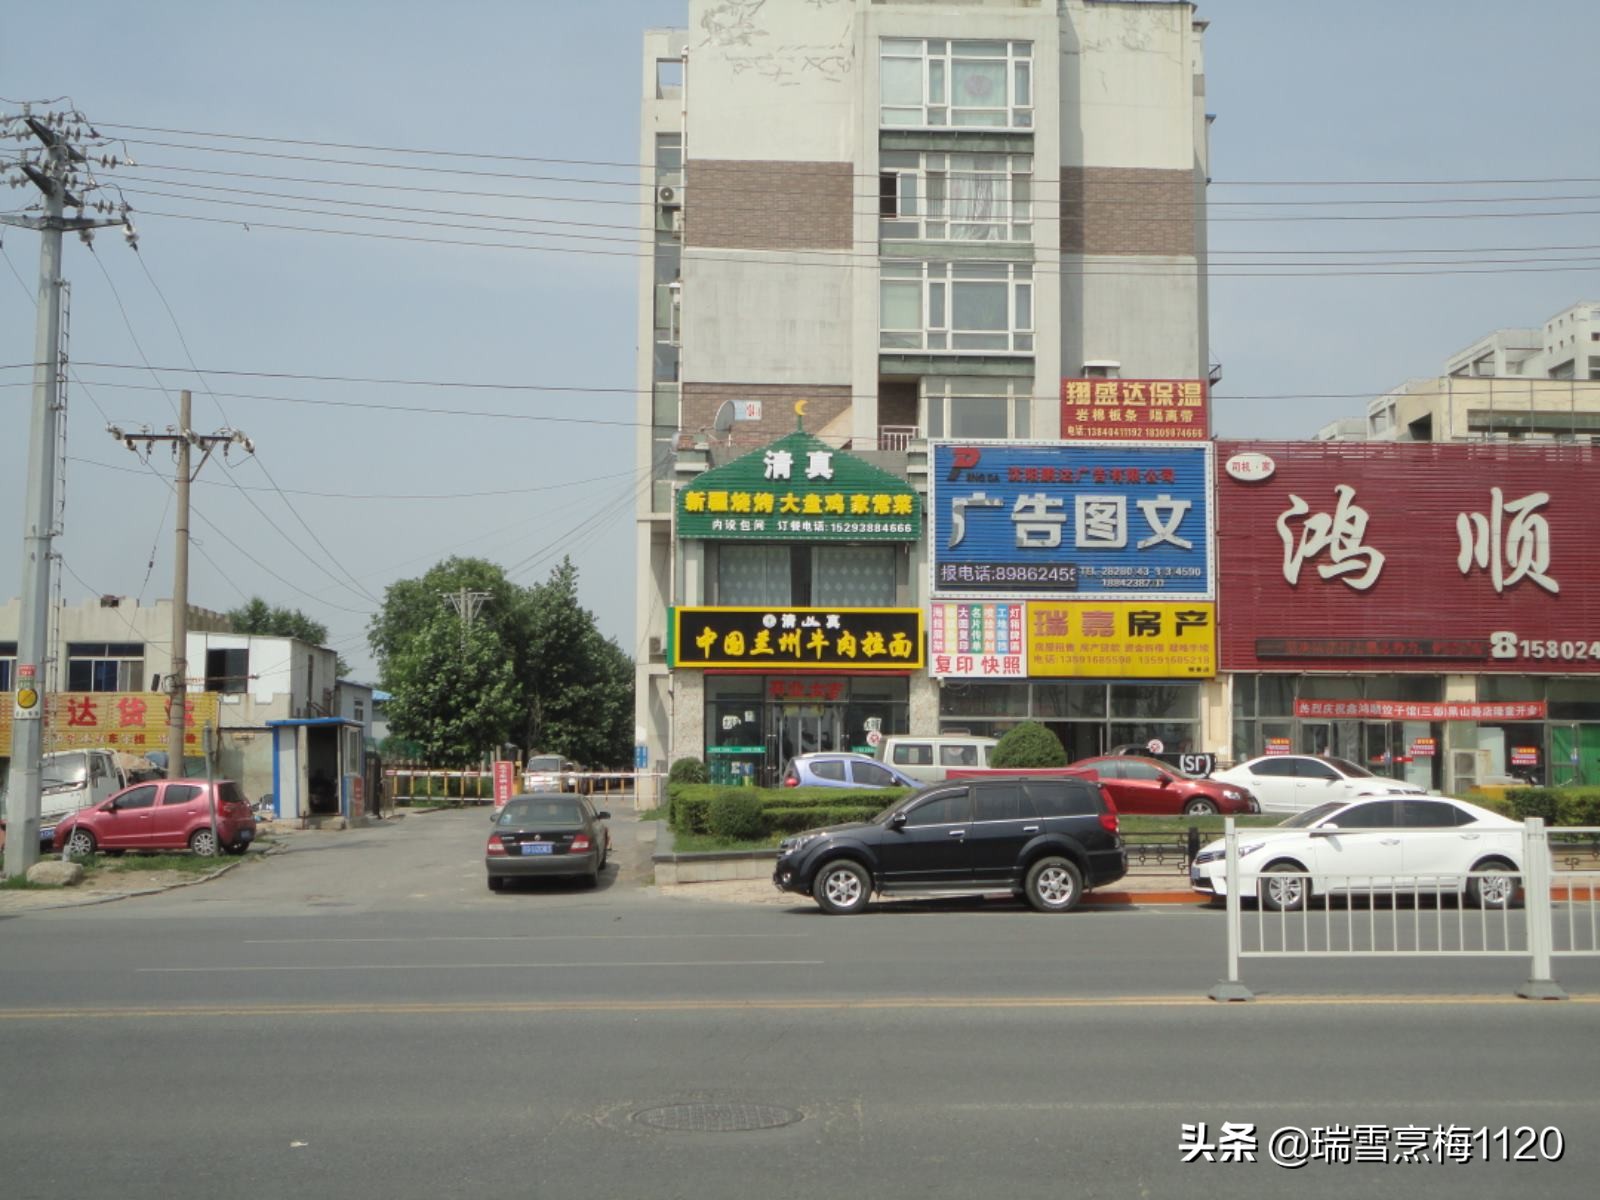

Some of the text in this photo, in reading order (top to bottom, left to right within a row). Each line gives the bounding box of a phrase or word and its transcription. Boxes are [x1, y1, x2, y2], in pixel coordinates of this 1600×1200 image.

[763, 450, 834, 480] 清真
[685, 491, 913, 515] 新疆烧烤 大盘鸡 家常菜
[712, 519, 765, 532] 内设包间
[948, 492, 1193, 550] 广告图文
[695, 627, 913, 660] 中国兰州牛肉拉面
[935, 655, 1020, 674] 复印 快照
